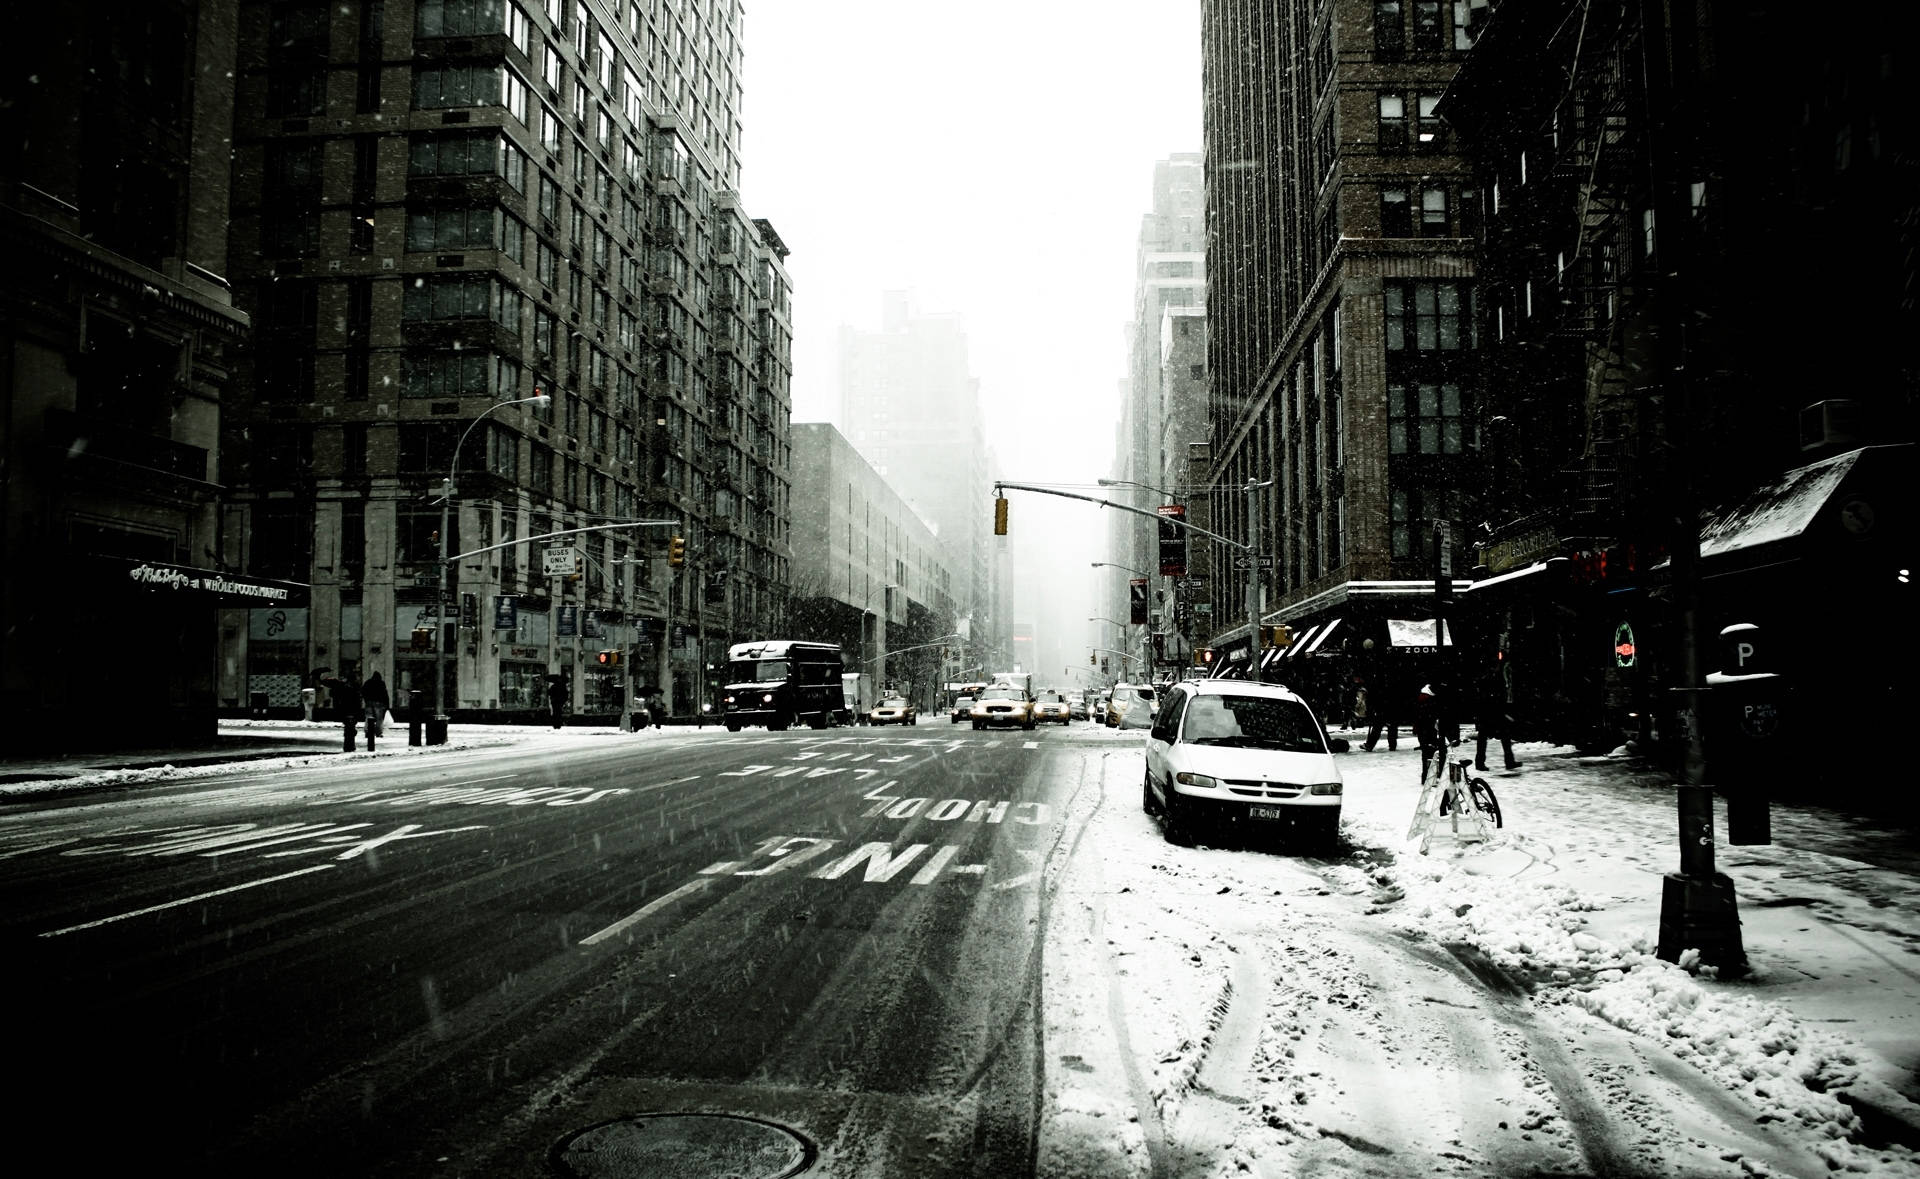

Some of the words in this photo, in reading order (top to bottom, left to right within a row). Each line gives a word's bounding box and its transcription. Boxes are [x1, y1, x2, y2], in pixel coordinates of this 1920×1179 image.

[203, 576, 234, 592] WHOLE
[234, 582, 258, 596] FOODS
[258, 587, 288, 600] MARKET
[1738, 643, 1754, 667] P
